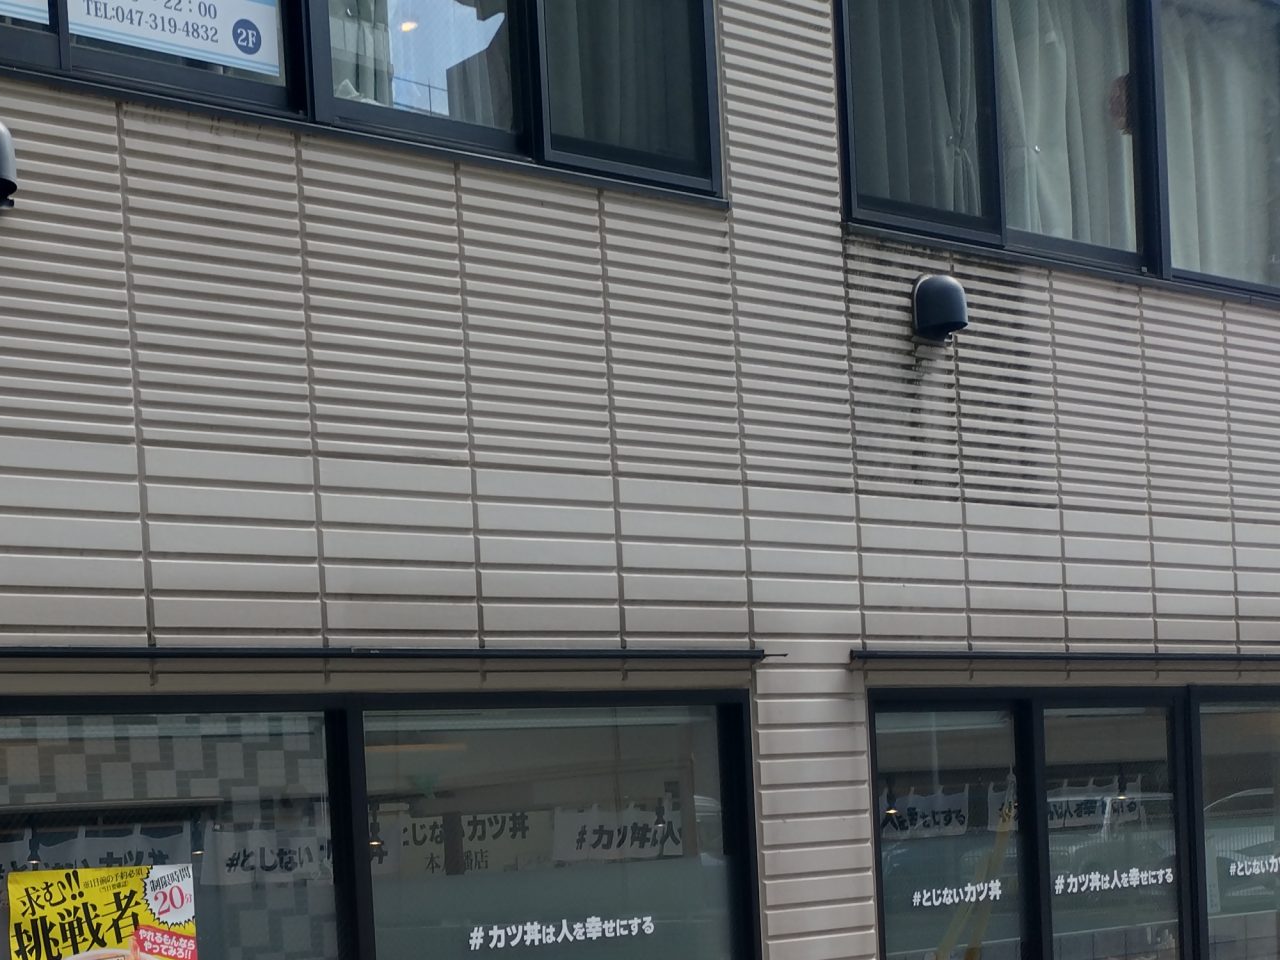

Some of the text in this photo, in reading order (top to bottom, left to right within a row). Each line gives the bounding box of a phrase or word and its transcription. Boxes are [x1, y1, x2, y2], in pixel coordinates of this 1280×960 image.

[83, 0, 219, 43] TEL:047-319-4832
[237, 27, 258, 48] 2F
[150, 866, 191, 893] 制限時間
[1229, 855, 1280, 877] #とじないカ
[912, 879, 1002, 907] #とじないカツ丼
[1054, 867, 1174, 895] #カツ丼は人を幸せにする
[139, 929, 196, 951] やれるもんなら
[468, 915, 655, 951] #カツ丼は人を幸せにする
